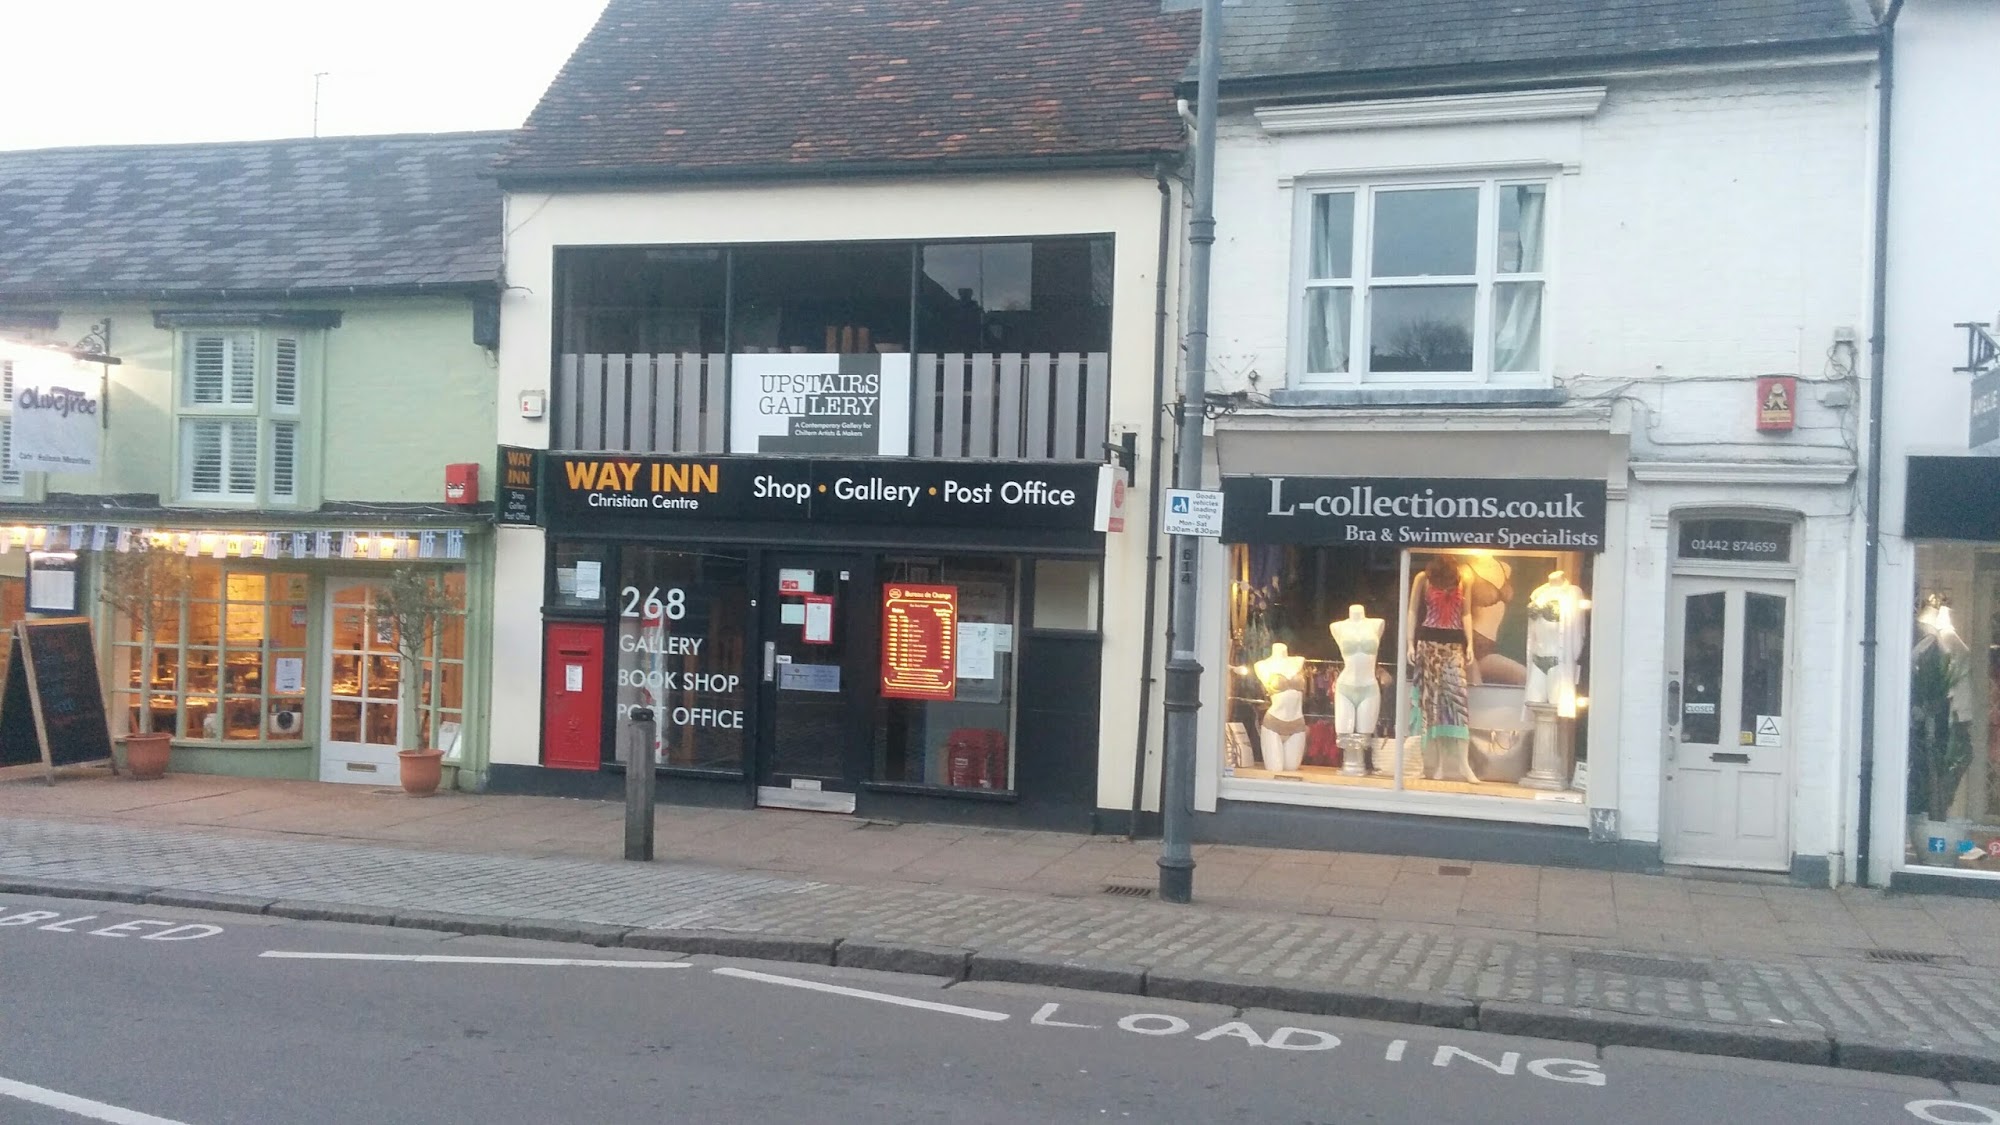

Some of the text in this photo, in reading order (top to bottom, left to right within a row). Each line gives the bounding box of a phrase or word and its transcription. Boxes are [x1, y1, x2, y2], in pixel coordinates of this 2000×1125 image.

[760, 374, 879, 394] UPSTAIRS
[759, 396, 878, 416] GALLERY
[1763, 400, 1789, 411] SAS
[507, 451, 532, 467] WAY
[508, 469, 530, 485] INN
[565, 461, 719, 494] WAY INN
[511, 491, 526, 502] Shop
[588, 493, 699, 510] Christian Centre
[753, 476, 1076, 507] Shop Gallery Post Office
[1267, 477, 1585, 520] L-collections.co.uk
[508, 501, 527, 512] Gallery
[515, 511, 531, 521] Office
[1345, 524, 1599, 549] Bra & Swimwear Specialists
[1690, 539, 1778, 554] 01442 874659
[620, 585, 686, 620] 268
[904, 590, 924, 598] Bureau
[619, 634, 703, 656] GALLERY
[618, 669, 740, 693] BOOK SHOP
[672, 706, 744, 729] OFFICE
[1685, 705, 1714, 713] CLOSED
[0, 906, 224, 941] BLED
[1030, 1002, 1606, 1087] LOADING
